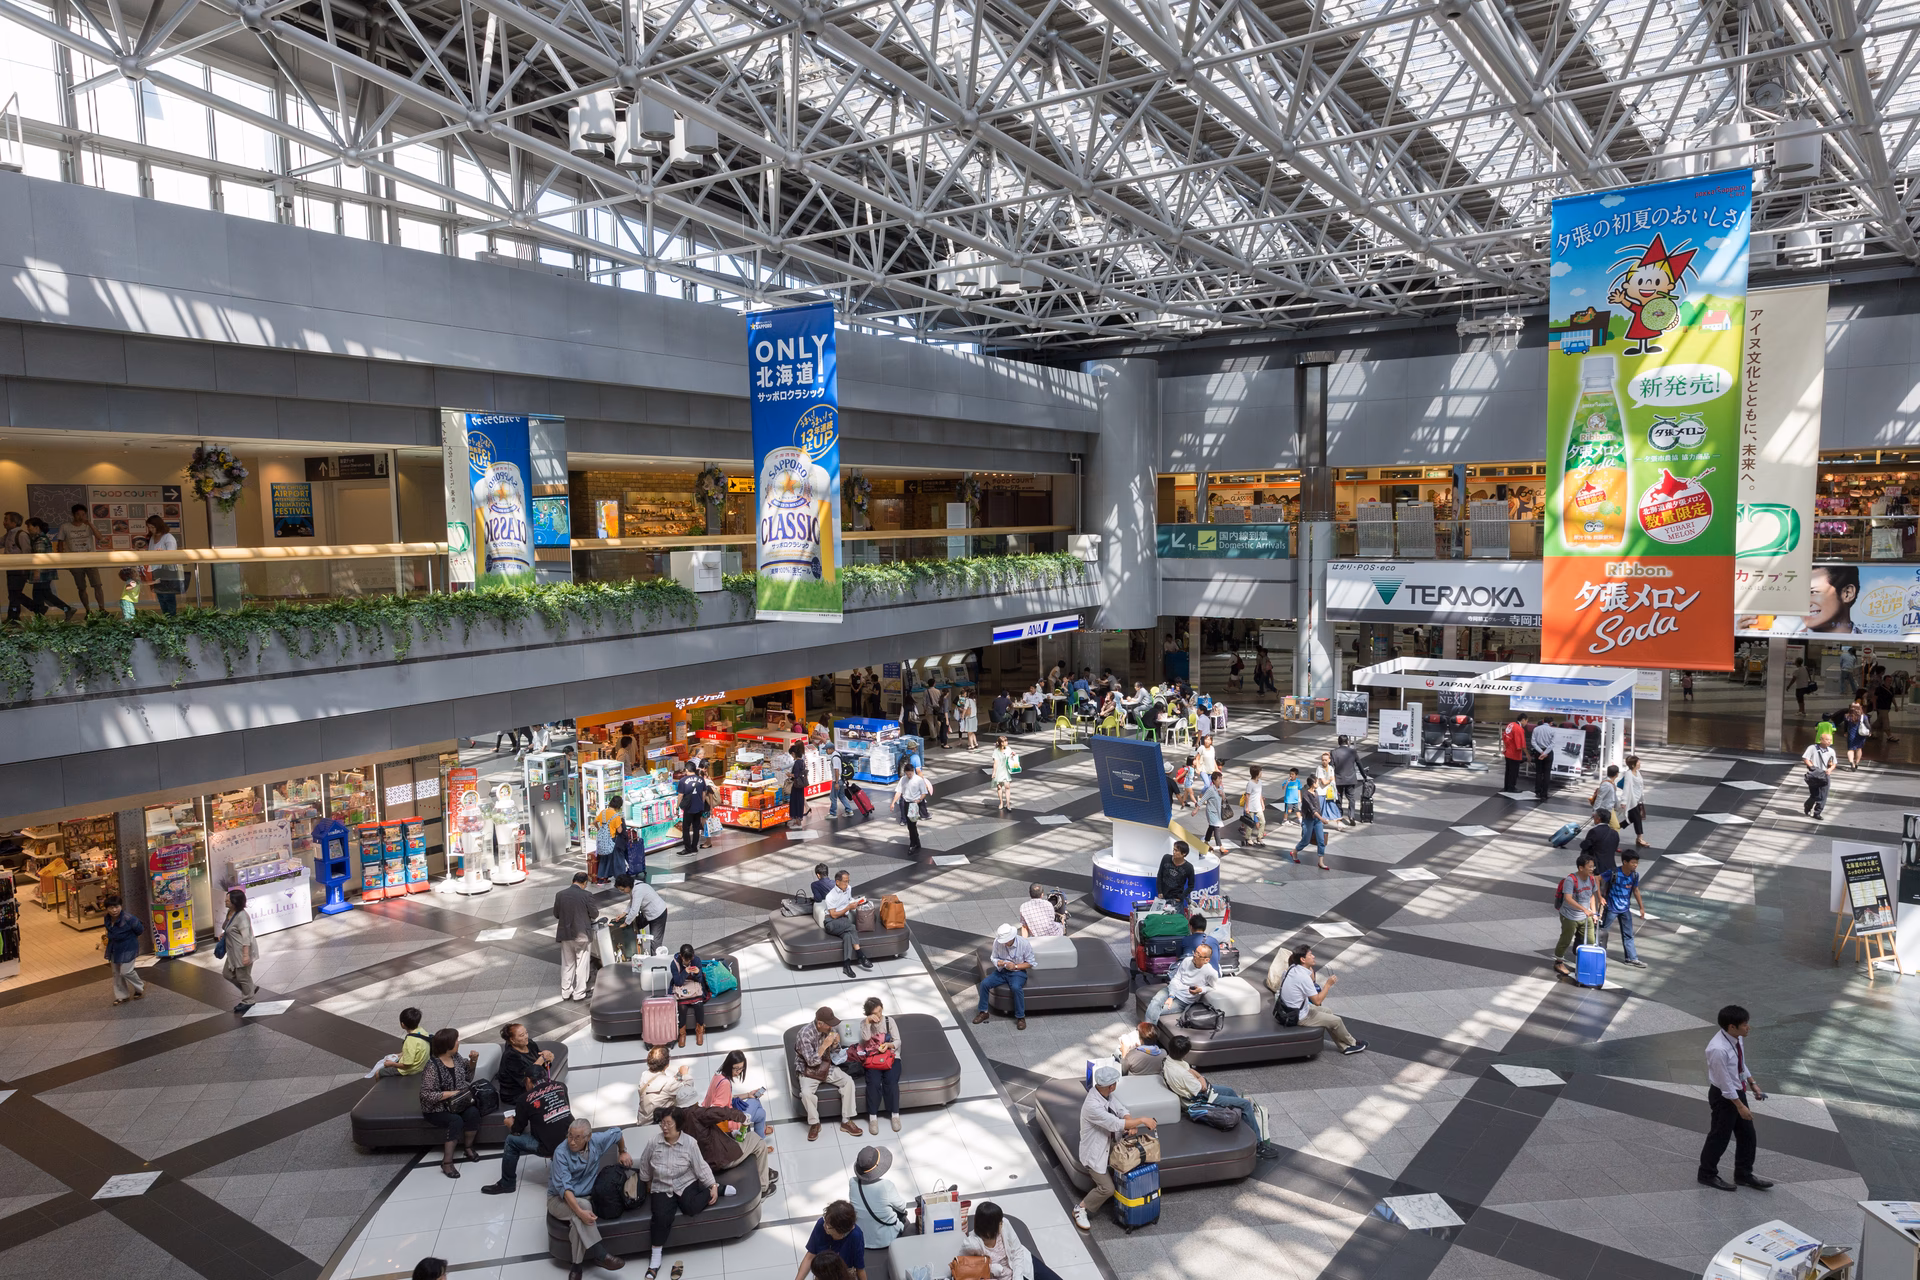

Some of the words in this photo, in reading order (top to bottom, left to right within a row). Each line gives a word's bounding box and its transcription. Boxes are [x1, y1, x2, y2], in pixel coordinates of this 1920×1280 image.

[1556, 205, 1746, 256] 夕張の初夏のおいしさ!
[756, 334, 828, 375] ONLY
[1640, 372, 1721, 398] 新発売!
[758, 387, 825, 402] サッポロクラシック
[1741, 309, 1764, 491] アイヌ文化とともに、未来へ。
[1655, 426, 1708, 437] 夕張メロン
[1568, 444, 1625, 459] 夕張メロン
[768, 459, 808, 480] SAPPORO
[1574, 457, 1615, 478] Soda
[93, 490, 122, 498] FOOD
[124, 490, 159, 498] COURT
[1645, 502, 1708, 529] 数量限定
[761, 512, 820, 545] CLASSIC
[1665, 522, 1695, 534] YUBARI
[1668, 528, 1696, 540] MELON
[1219, 531, 1268, 541] 国内線到着
[772, 541, 809, 549] サッポロクラシック
[1219, 541, 1254, 549] Domestic
[1256, 541, 1286, 549] Arrivals
[1606, 564, 1667, 576] Ribbon
[1405, 585, 1525, 608] TERAOKA
[1574, 581, 1701, 613] 夕張メロン
[1027, 623, 1042, 636] ANA
[1588, 611, 1679, 654] Soda
[1473, 683, 1523, 692] AIRLINES
[1440, 696, 1467, 705] NEXT
[250, 902, 298, 919] uLuLun
